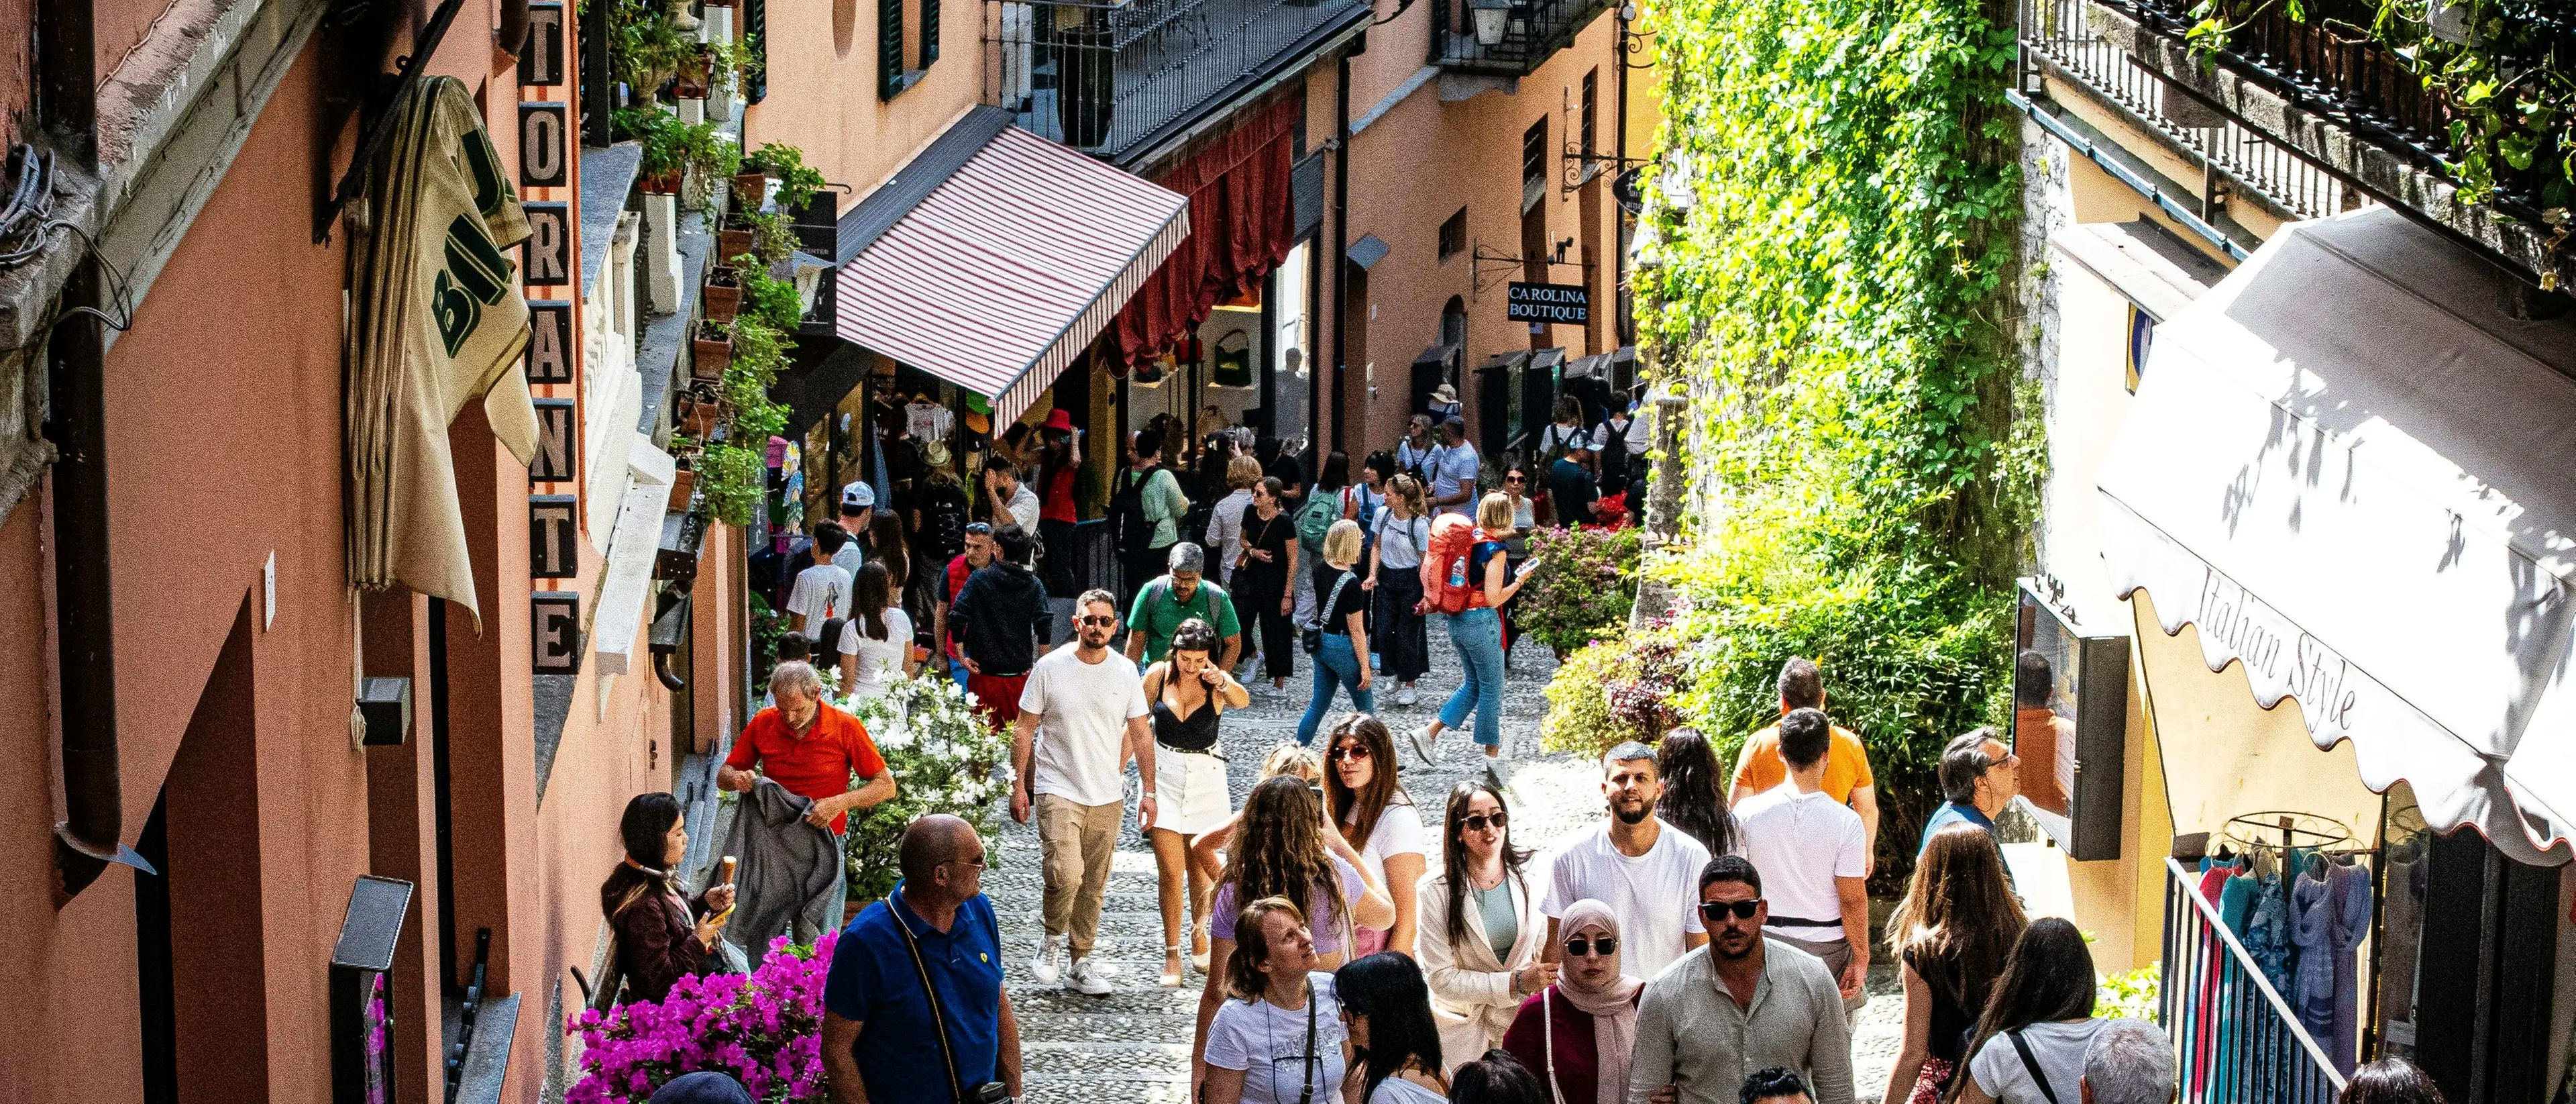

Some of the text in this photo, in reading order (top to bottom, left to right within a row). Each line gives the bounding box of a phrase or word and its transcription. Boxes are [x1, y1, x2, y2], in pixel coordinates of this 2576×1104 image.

[1509, 287, 1587, 303] CAROLINA
[1509, 303, 1587, 321] BOUTIQUE
[2196, 564, 2355, 734] Italian Style
